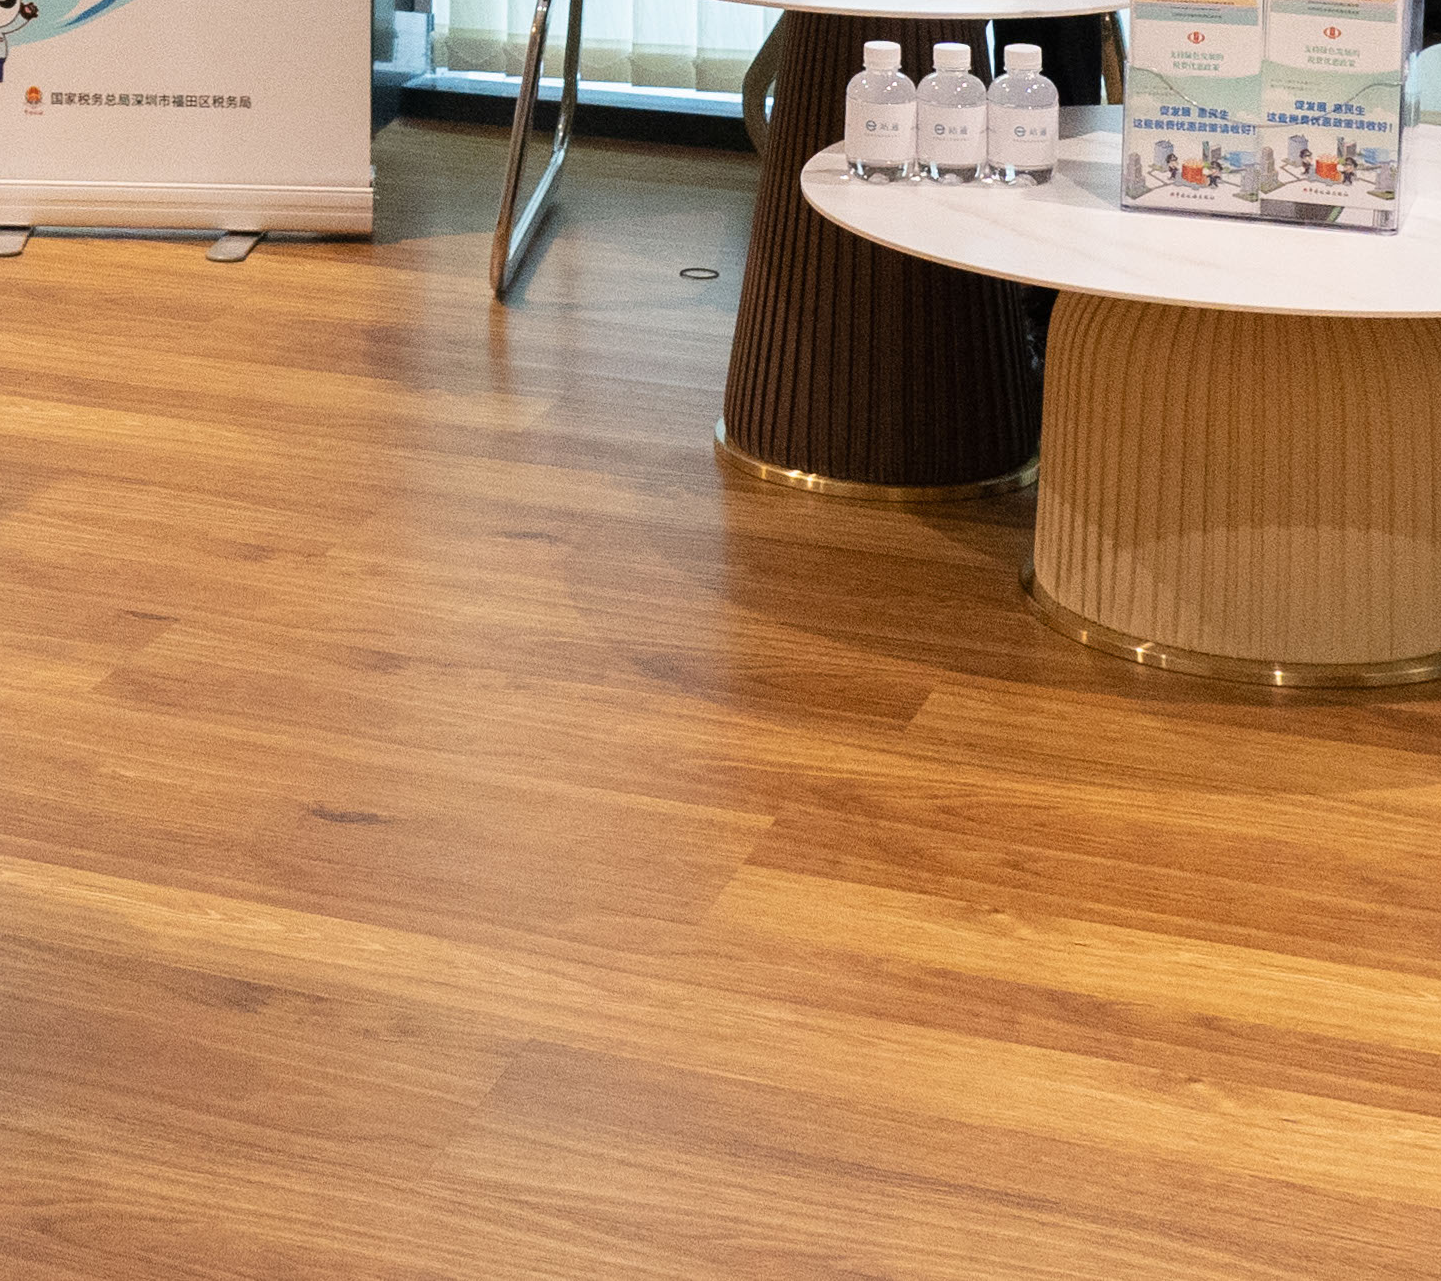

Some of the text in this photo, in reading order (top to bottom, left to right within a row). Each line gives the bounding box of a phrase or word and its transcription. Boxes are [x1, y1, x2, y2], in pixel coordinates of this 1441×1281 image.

[50, 91, 252, 110] 国家税务总局深圳市福田区税务局
